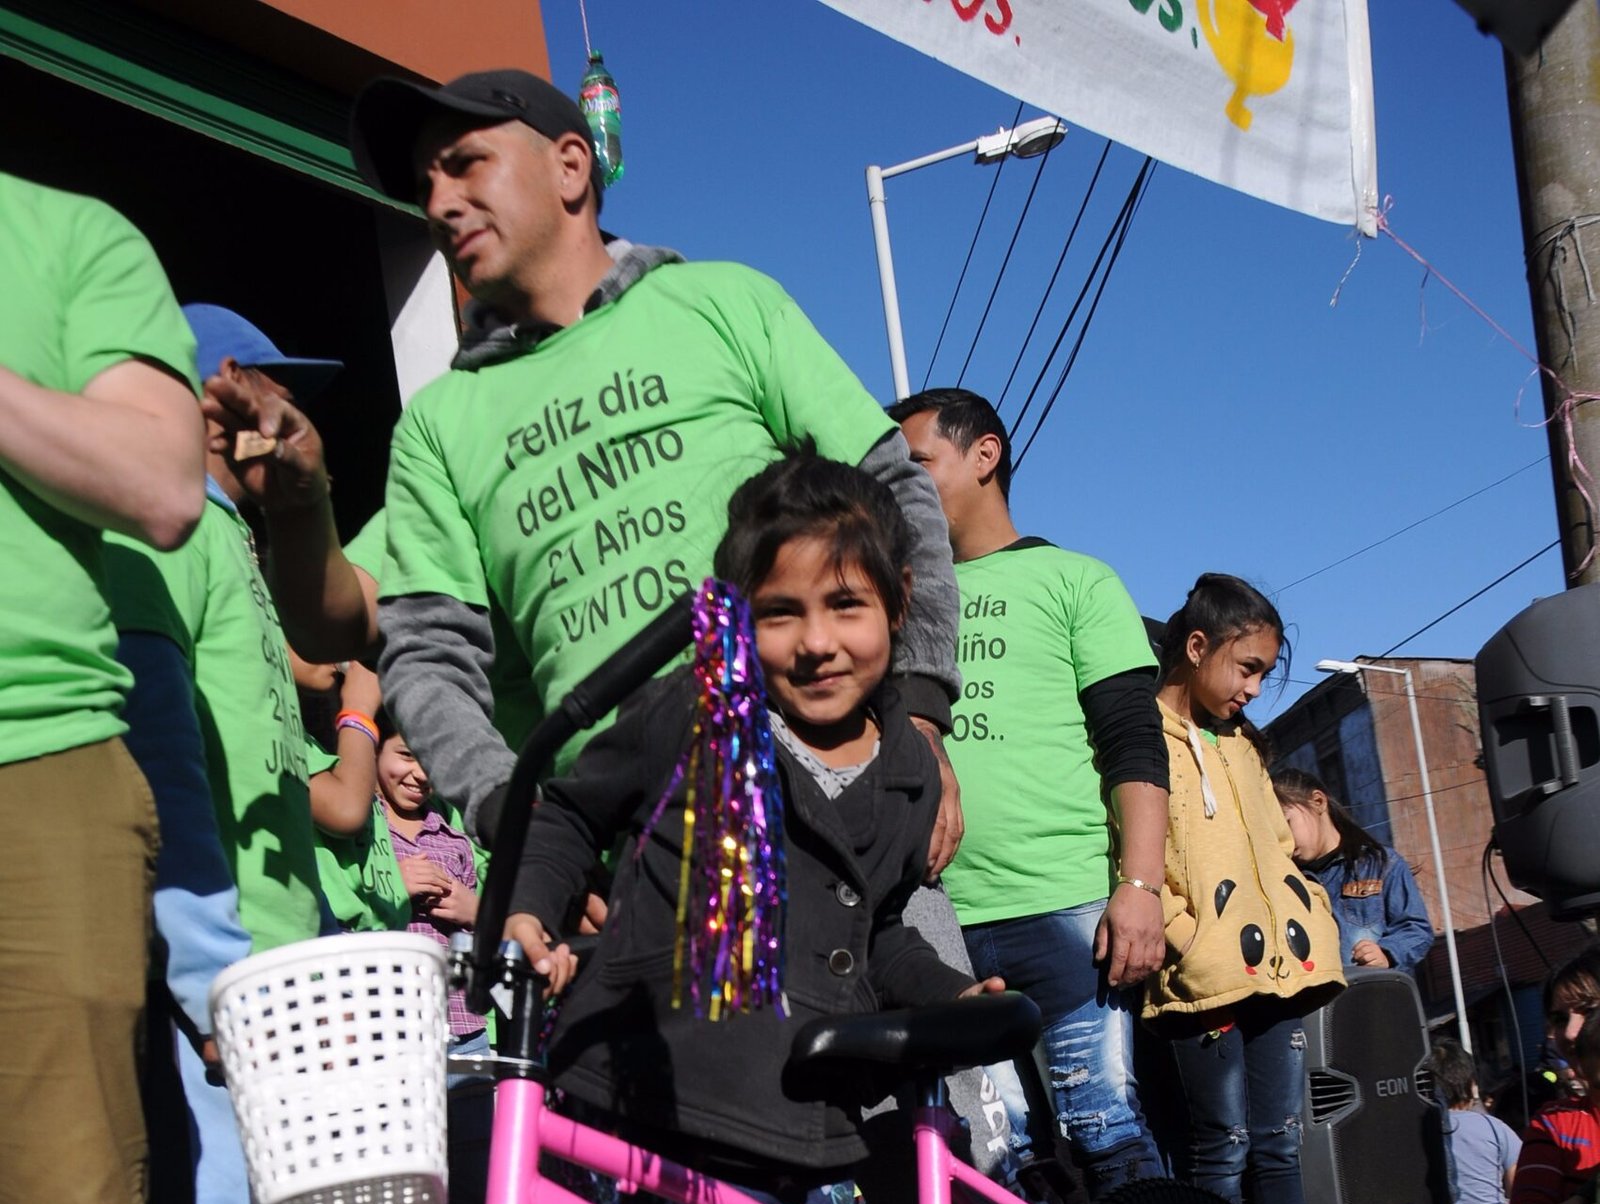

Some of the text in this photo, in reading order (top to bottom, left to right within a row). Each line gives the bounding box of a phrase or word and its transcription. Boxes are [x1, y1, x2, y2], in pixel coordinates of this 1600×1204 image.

[504, 368, 669, 471] Feliz día
[516, 466, 576, 538] del
[548, 500, 687, 590] 21 Años
[964, 594, 1007, 620] día
[954, 632, 1007, 663] iño
[1375, 1077, 1409, 1097] EON
